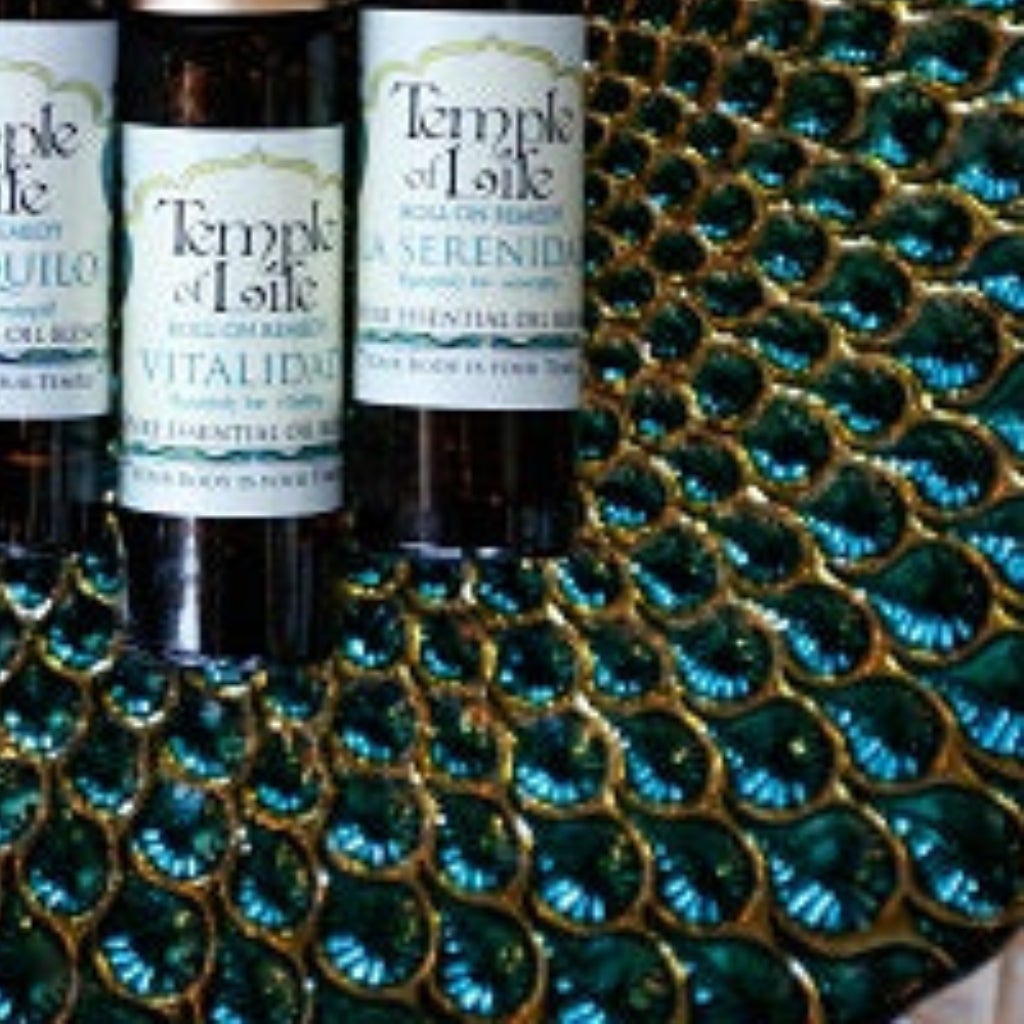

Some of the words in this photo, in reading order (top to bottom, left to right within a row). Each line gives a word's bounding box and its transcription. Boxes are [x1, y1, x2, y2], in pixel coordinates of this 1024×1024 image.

[389, 80, 576, 162] Temple
[404, 156, 439, 189] of
[445, 143, 555, 201] Life
[154, 198, 340, 274] Temple
[173, 269, 209, 304] of
[213, 259, 318, 314] Life
